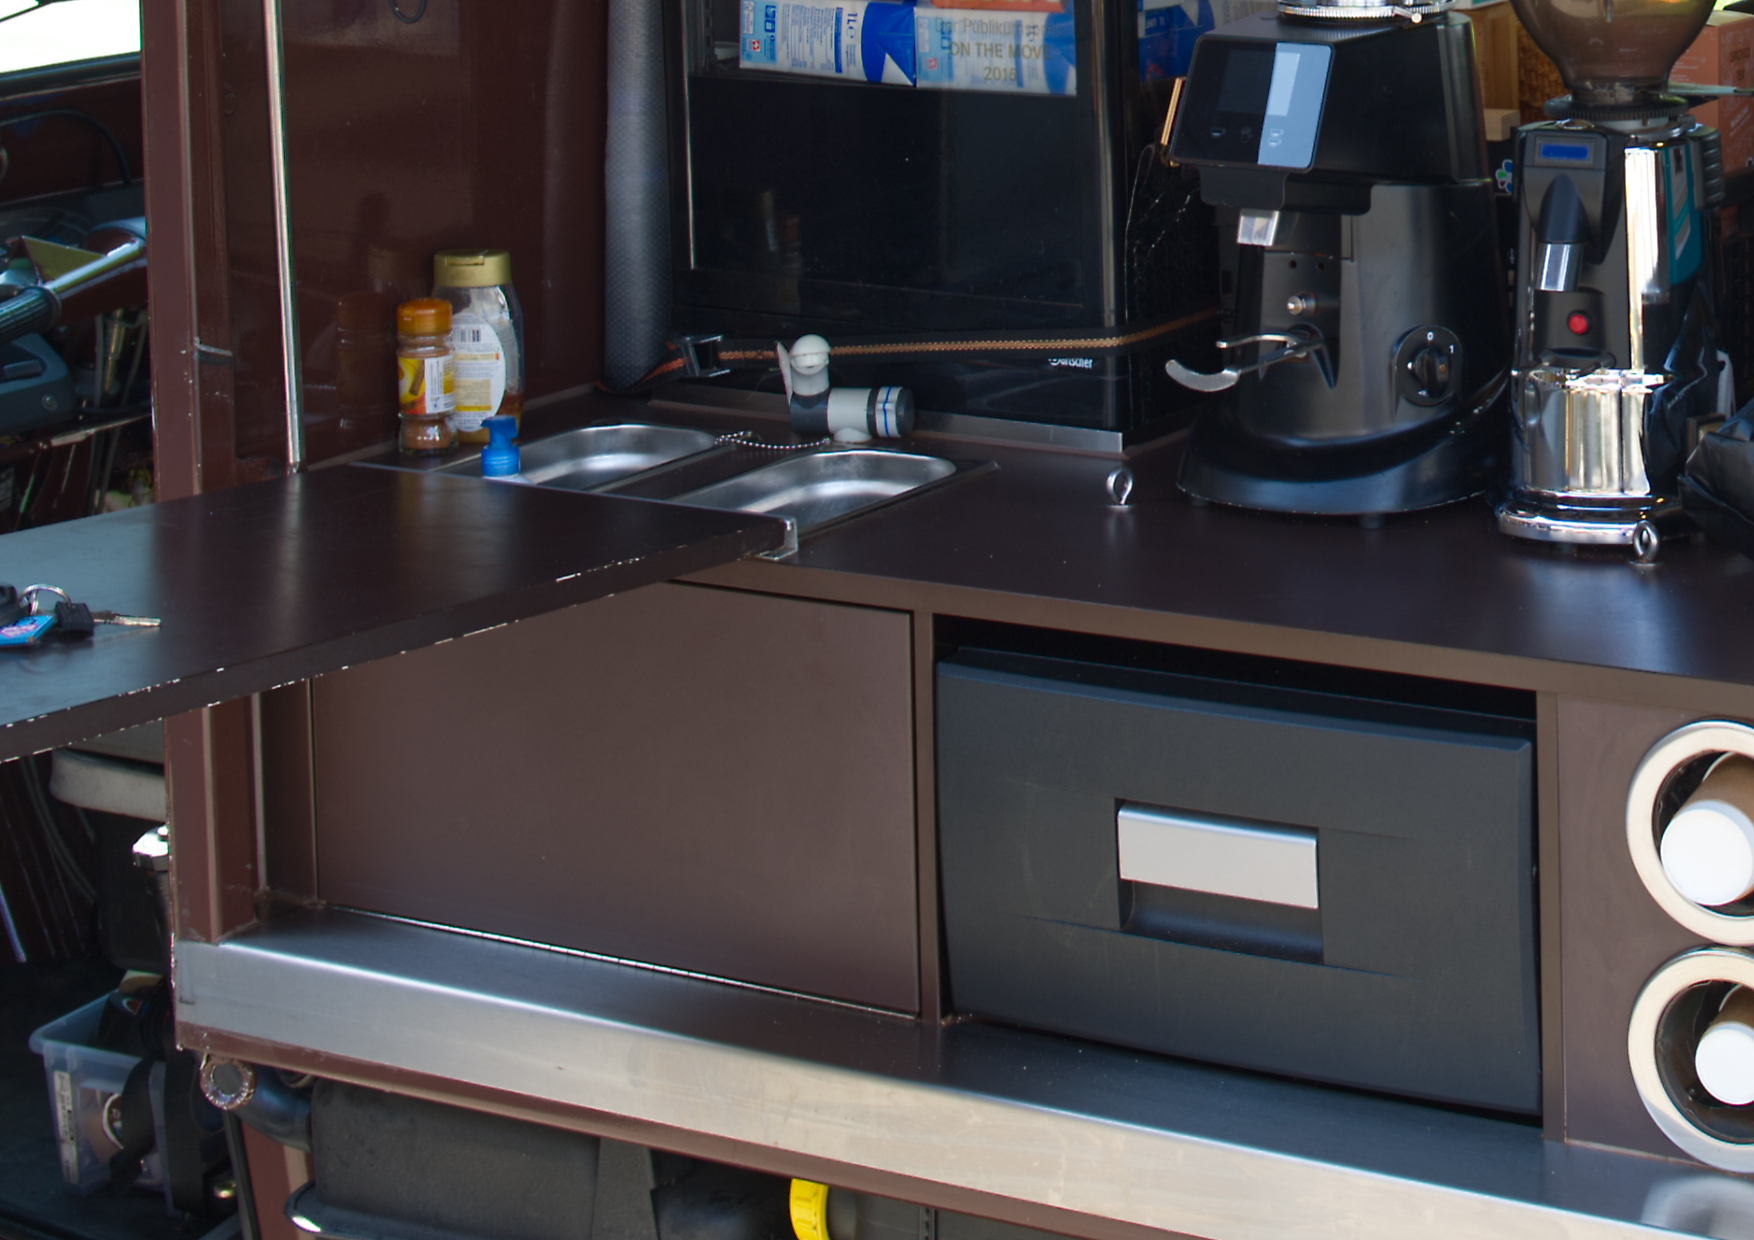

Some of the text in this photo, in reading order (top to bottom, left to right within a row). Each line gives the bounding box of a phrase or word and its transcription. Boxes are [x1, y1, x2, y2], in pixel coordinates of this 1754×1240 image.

[949, 41, 971, 57] ON
[975, 41, 1003, 58] THE
[1427, 331, 1434, 341] 0
